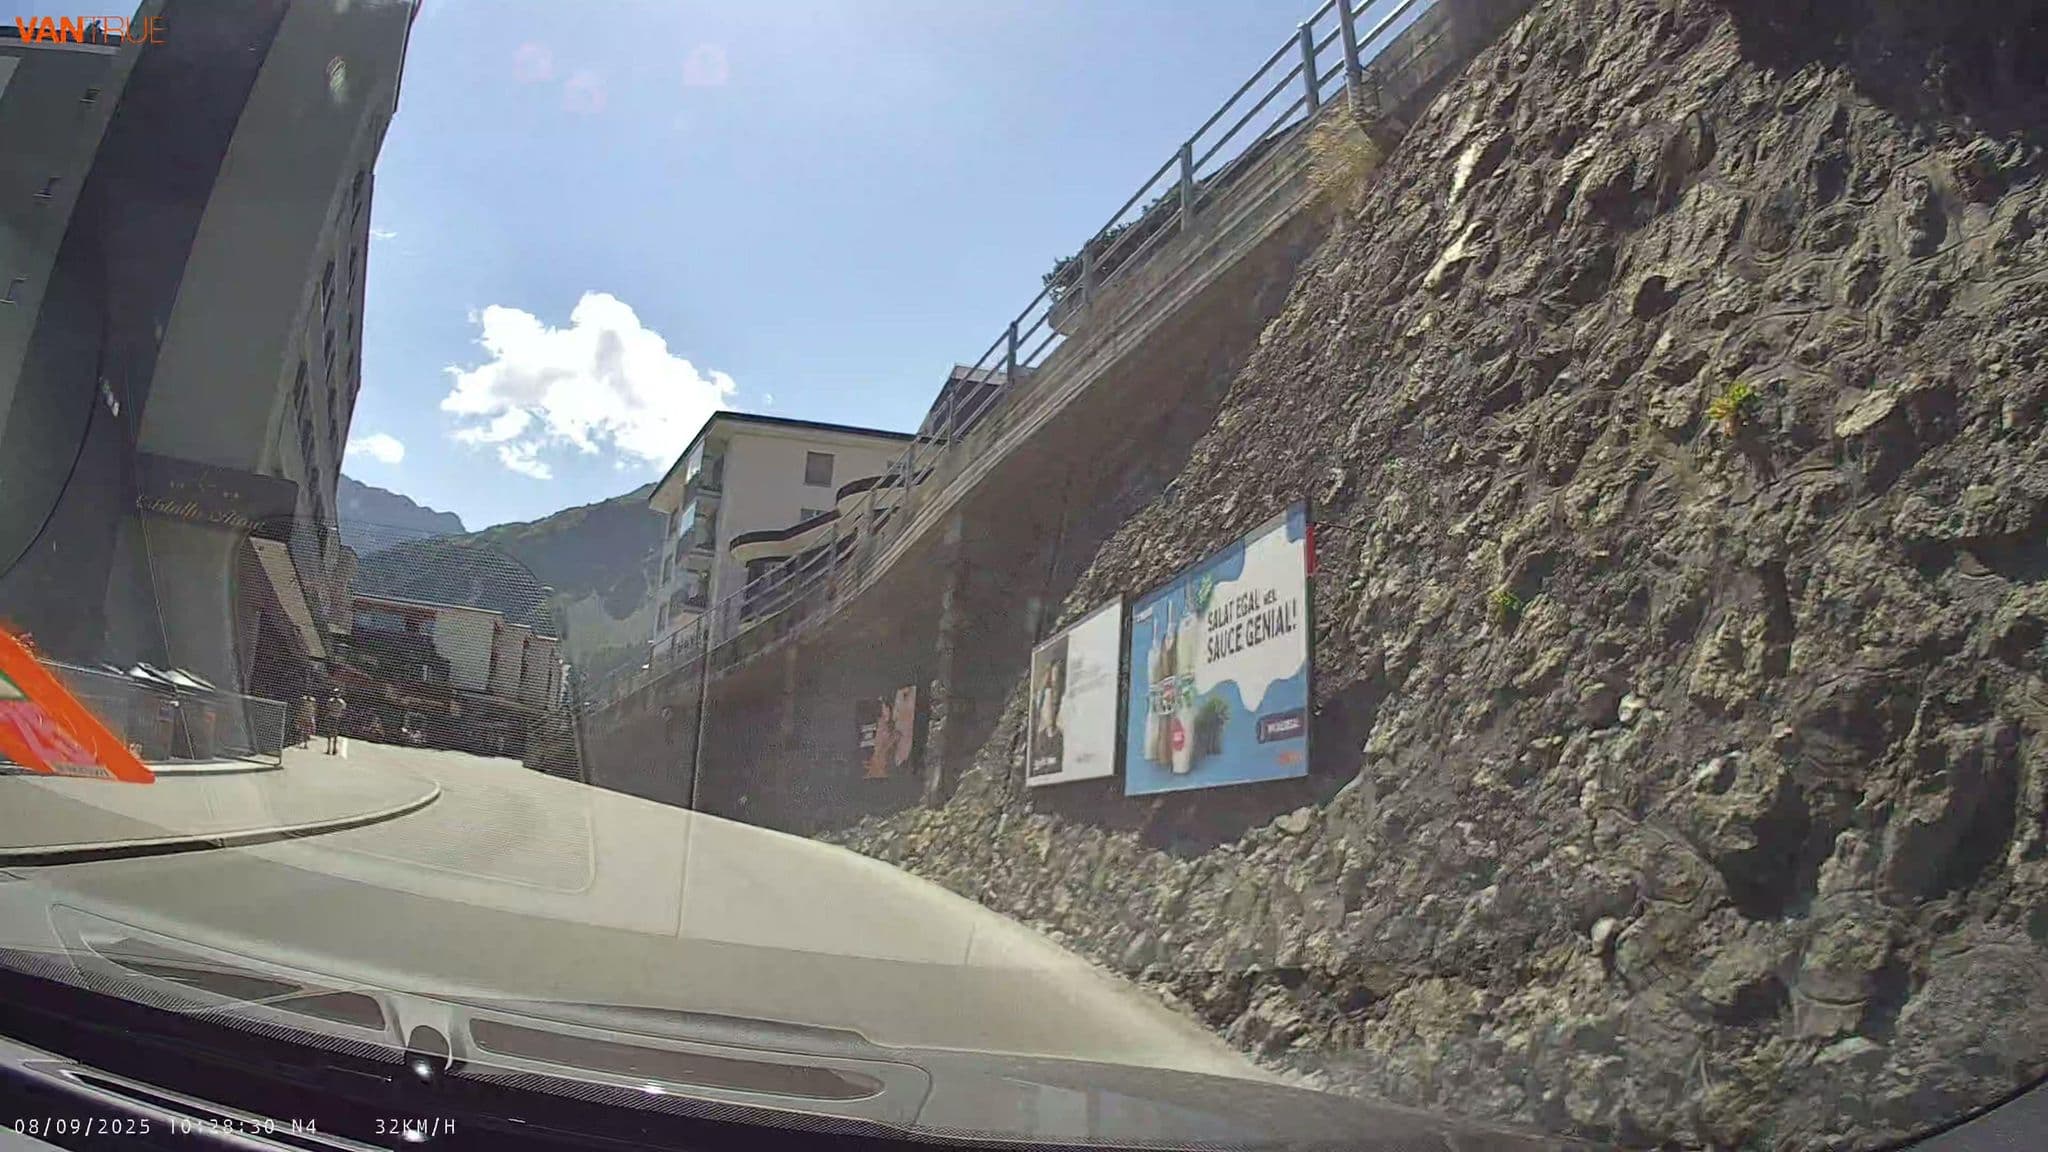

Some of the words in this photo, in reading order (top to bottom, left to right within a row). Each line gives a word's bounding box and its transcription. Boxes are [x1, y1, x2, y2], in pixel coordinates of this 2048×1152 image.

[1208, 602, 1234, 632] SALAT
[1236, 589, 1260, 619] EGAL
[1208, 623, 1243, 664] SAUCE
[1246, 597, 1297, 646] GENIAL!
